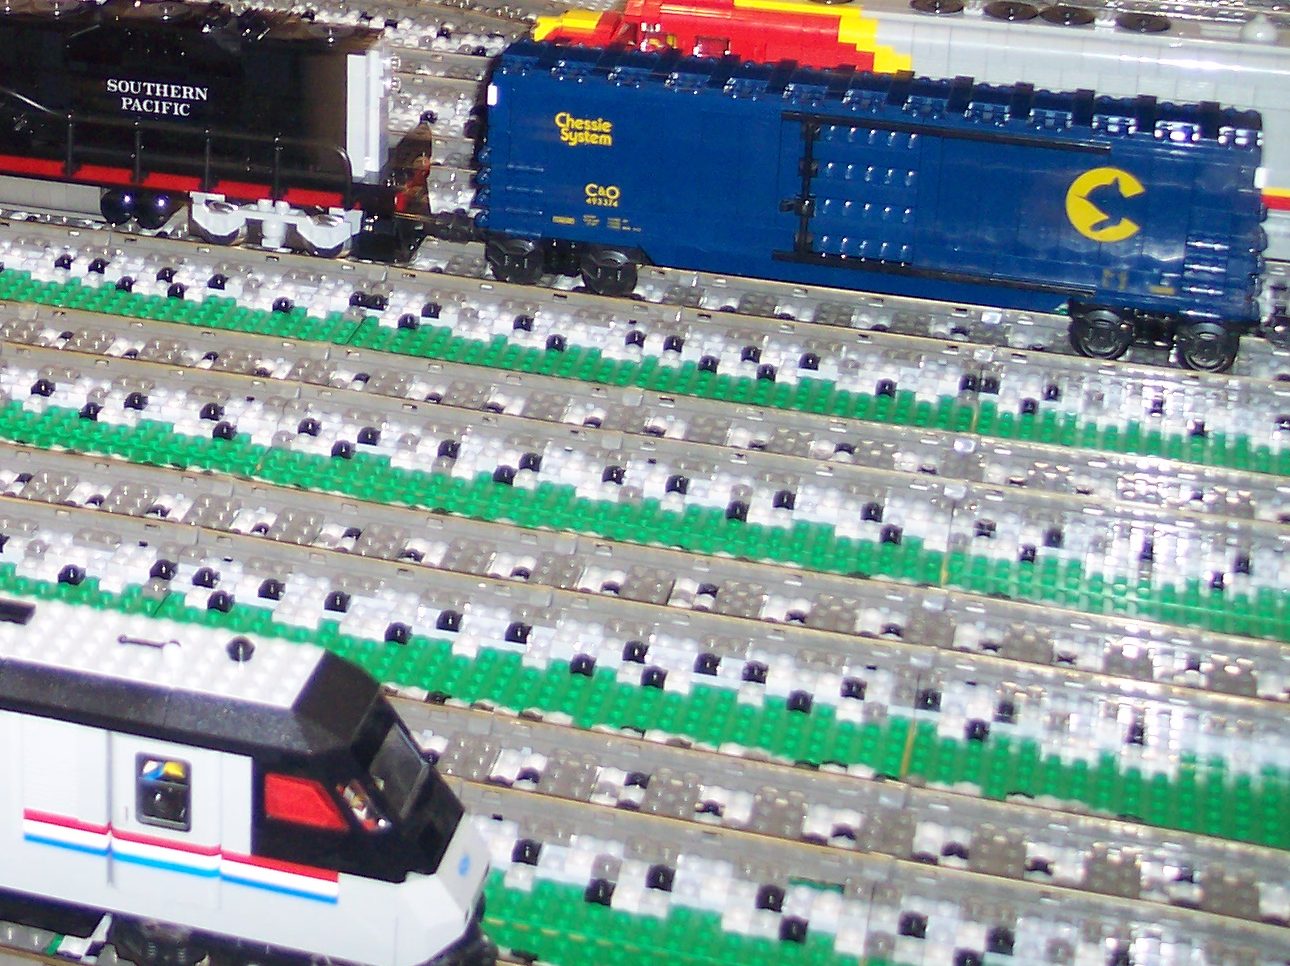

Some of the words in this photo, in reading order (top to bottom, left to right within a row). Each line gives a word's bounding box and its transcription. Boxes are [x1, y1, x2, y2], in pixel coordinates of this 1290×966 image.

[106, 78, 208, 101] SOUTHERN
[121, 97, 190, 116] PACIFIC
[554, 112, 612, 133] Chessie
[560, 128, 612, 146] System
[584, 183, 620, 200] C&O
